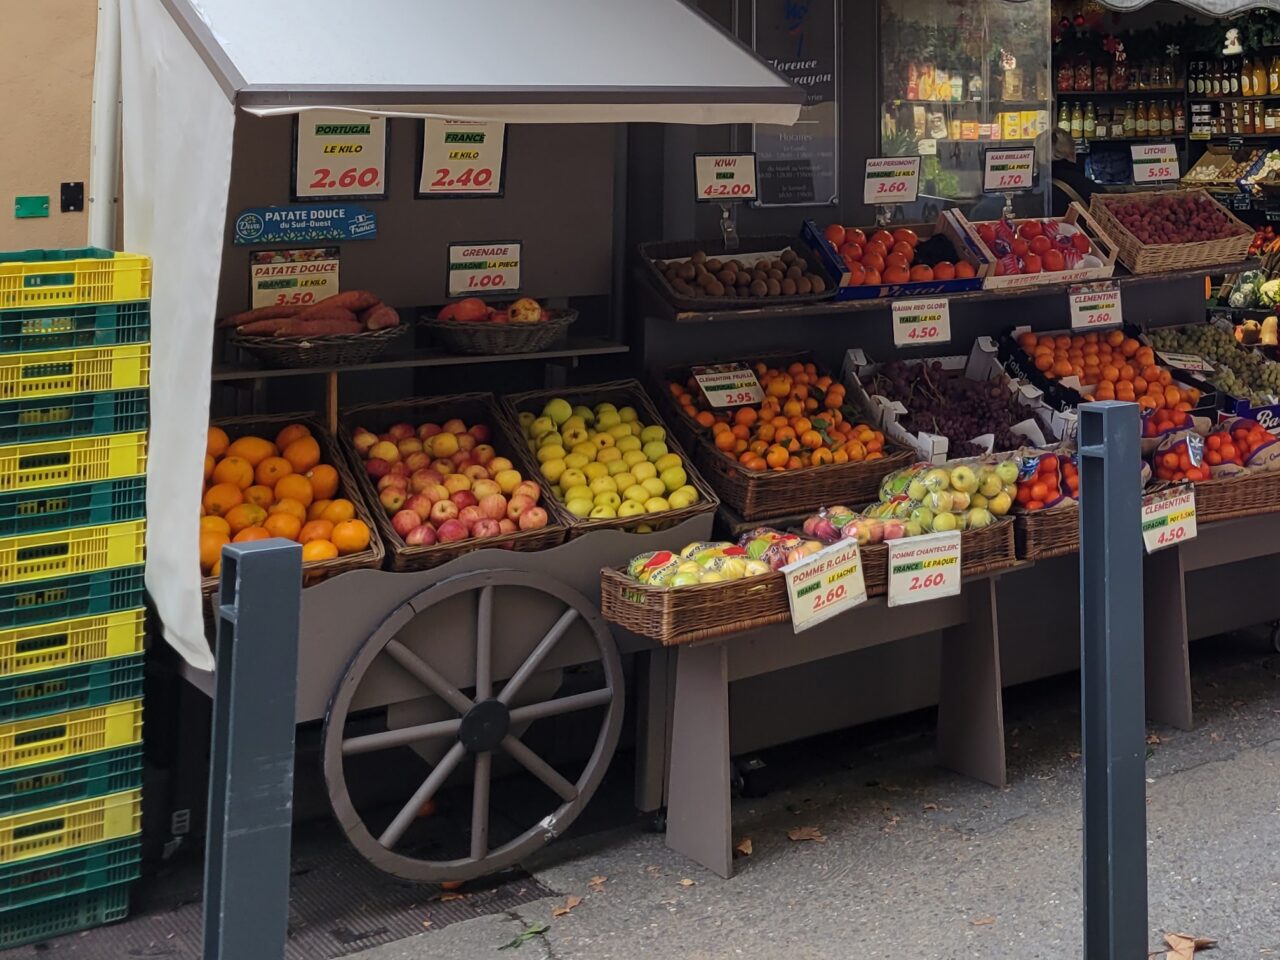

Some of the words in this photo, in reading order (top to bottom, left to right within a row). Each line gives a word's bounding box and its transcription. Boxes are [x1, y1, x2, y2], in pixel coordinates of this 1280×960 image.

[315, 126, 371, 135] PORTUGAL
[445, 133, 486, 143] FRANCE
[323, 145, 337, 153] LE
[338, 145, 363, 153] KILO
[460, 151, 480, 159] KILO
[714, 158, 737, 167] KIWI
[265, 210, 308, 221] PATATE
[310, 209, 346, 219] DOUCE
[280, 221, 290, 229] du
[291, 220, 332, 228] Sud-Ouest
[350, 223, 376, 235] France
[462, 247, 509, 257] GRENADE
[255, 265, 298, 276] PATATE
[300, 263, 337, 273] DOUCE
[309, 279, 327, 287] KILO
[1074, 292, 1119, 303] CLEMENTINE
[1145, 494, 1191, 515] CLEMENTINE
[892, 550, 915, 560] POMME
[916, 543, 959, 556] CHANTECLERC
[792, 562, 825, 585] POMME
[826, 549, 857, 570] R.GALA
[893, 562, 919, 574] FRANCE
[923, 561, 931, 569] LE
[931, 557, 959, 567] PAQUET
[797, 581, 821, 598] FRANCE
[828, 574, 836, 583] LE
[836, 565, 857, 579] SACHET
